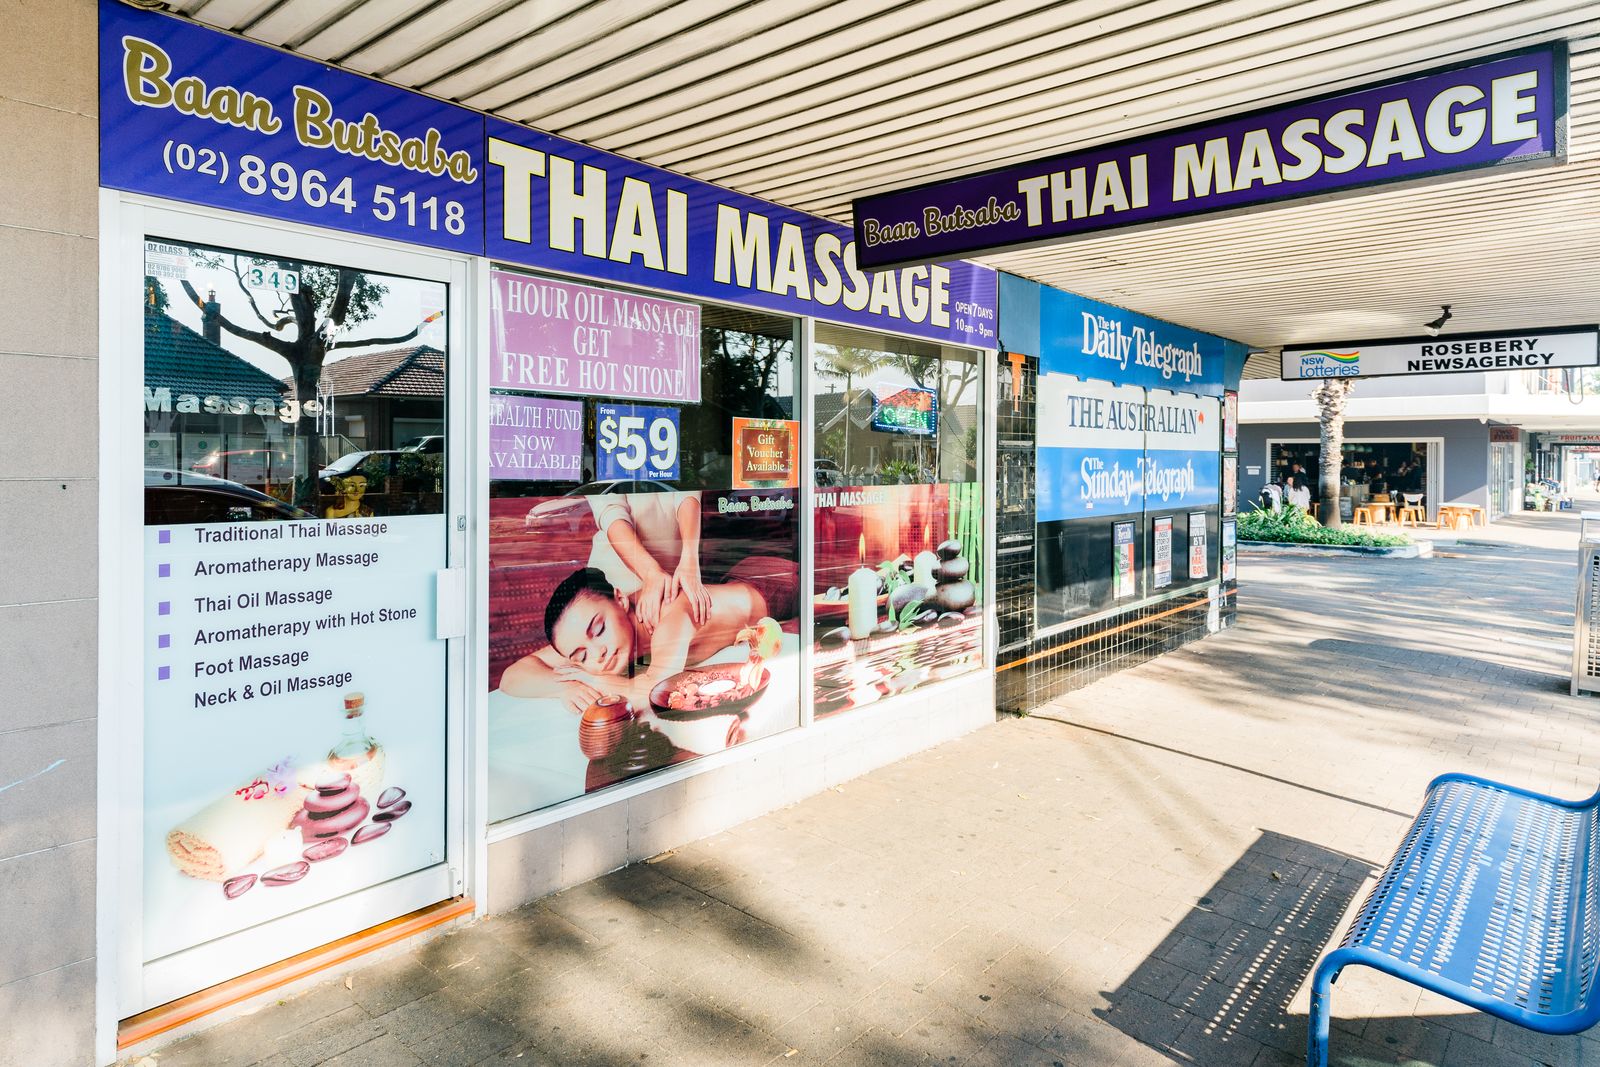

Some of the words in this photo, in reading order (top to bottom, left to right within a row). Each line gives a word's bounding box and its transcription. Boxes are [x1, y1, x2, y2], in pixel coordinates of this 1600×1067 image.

[122, 35, 282, 135] Baan
[293, 85, 478, 184] Butsaba
[864, 218, 920, 247] Baan
[923, 197, 1021, 237] Butsaba
[1017, 153, 1149, 228] THAI
[1172, 70, 1538, 202] MASSAGE
[163, 140, 229, 184] (02)
[238, 154, 357, 214] 8964
[372, 184, 466, 235] 5118
[488, 136, 688, 275] THAI
[714, 203, 950, 328] MASSAGE
[148, 242, 158, 252] OZ
[159, 245, 183, 256] GLASS
[250, 267, 297, 292] 349
[506, 279, 569, 320] HOUR
[574, 291, 609, 326] OIL
[613, 297, 695, 337] MASSAGE
[955, 318, 974, 333] 10am
[979, 322, 994, 338] 9pm
[1098, 315, 1110, 330] The
[574, 325, 612, 358] GET
[1081, 312, 1132, 371] Daily
[1132, 325, 1202, 382] Telegraph
[1421, 338, 1539, 357] ROSEBERY
[1300, 364, 1360, 378] Lotteries
[1302, 356, 1325, 366] NSW
[1407, 352, 1555, 372] NEWSAGENCY
[500, 352, 569, 387] FREE
[579, 360, 618, 391] HOT
[622, 364, 684, 396] SITONE
[144, 387, 323, 423] Massage
[600, 407, 616, 415] From
[1067, 396, 1104, 429] THE
[1107, 402, 1198, 435] AUSTRALIAN
[546, 408, 582, 431] FUND
[883, 406, 928, 430] OPEN
[513, 435, 556, 451] NOW
[599, 416, 678, 471] $59
[746, 444, 784, 458] Voucher
[758, 434, 775, 445] Gift
[489, 452, 582, 470] AVAILABLE
[746, 461, 785, 472] Available
[1092, 459, 1104, 471] The
[1080, 456, 1134, 506] Sunday
[1137, 457, 1195, 502] Telegraph
[718, 497, 749, 514] Baan
[750, 496, 794, 512] Butsaba
[814, 492, 837, 508] THAI
[195, 524, 283, 544] Traditional
[288, 523, 321, 539] Thai
[325, 520, 388, 538] Massage
[194, 556, 311, 577] Aromatherapy
[316, 552, 379, 568] Massage
[195, 596, 231, 613] Thai
[237, 592, 260, 609] Oil
[265, 588, 333, 606] Massage
[194, 623, 311, 646] Aromatherapy
[316, 613, 346, 630] with
[350, 610, 375, 626] Hot
[379, 606, 417, 622] Stone
[195, 658, 234, 678] Foot
[239, 650, 309, 672] Massage
[195, 686, 237, 708] Neck
[243, 684, 255, 700] &
[260, 680, 282, 697] Oil
[287, 672, 352, 692] Massage
